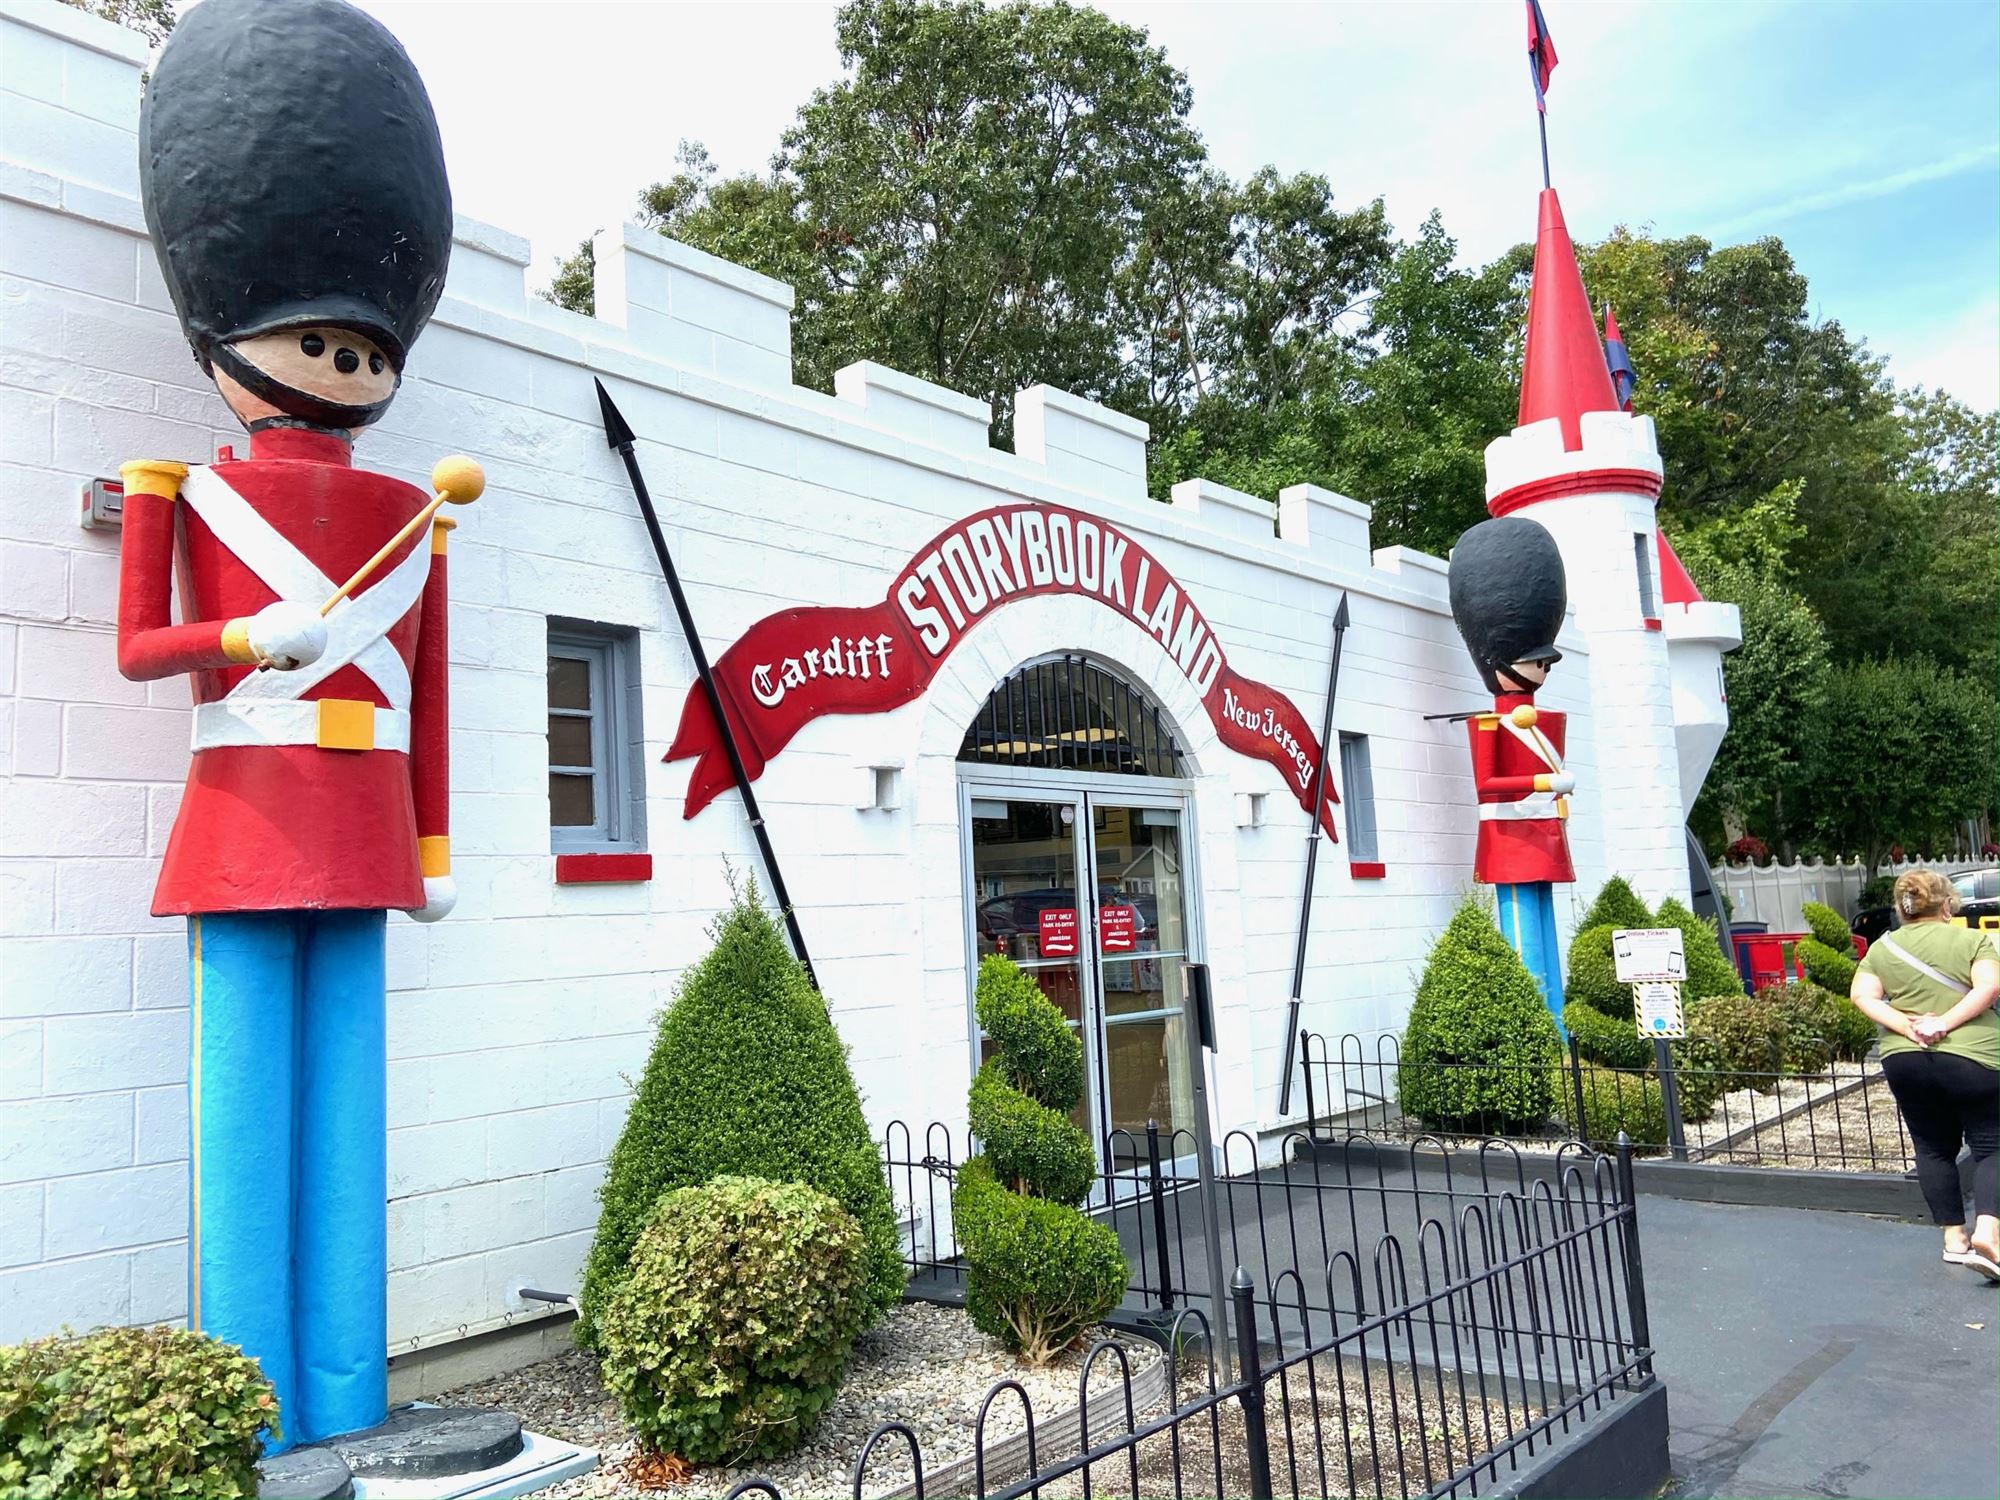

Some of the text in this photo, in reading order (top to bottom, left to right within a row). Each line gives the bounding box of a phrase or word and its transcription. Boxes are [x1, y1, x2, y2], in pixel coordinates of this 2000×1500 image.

[897, 510, 1223, 699] STORYBOOK LAND
[751, 633, 893, 706] Cardiff
[1223, 688, 1314, 790] New Jersey
